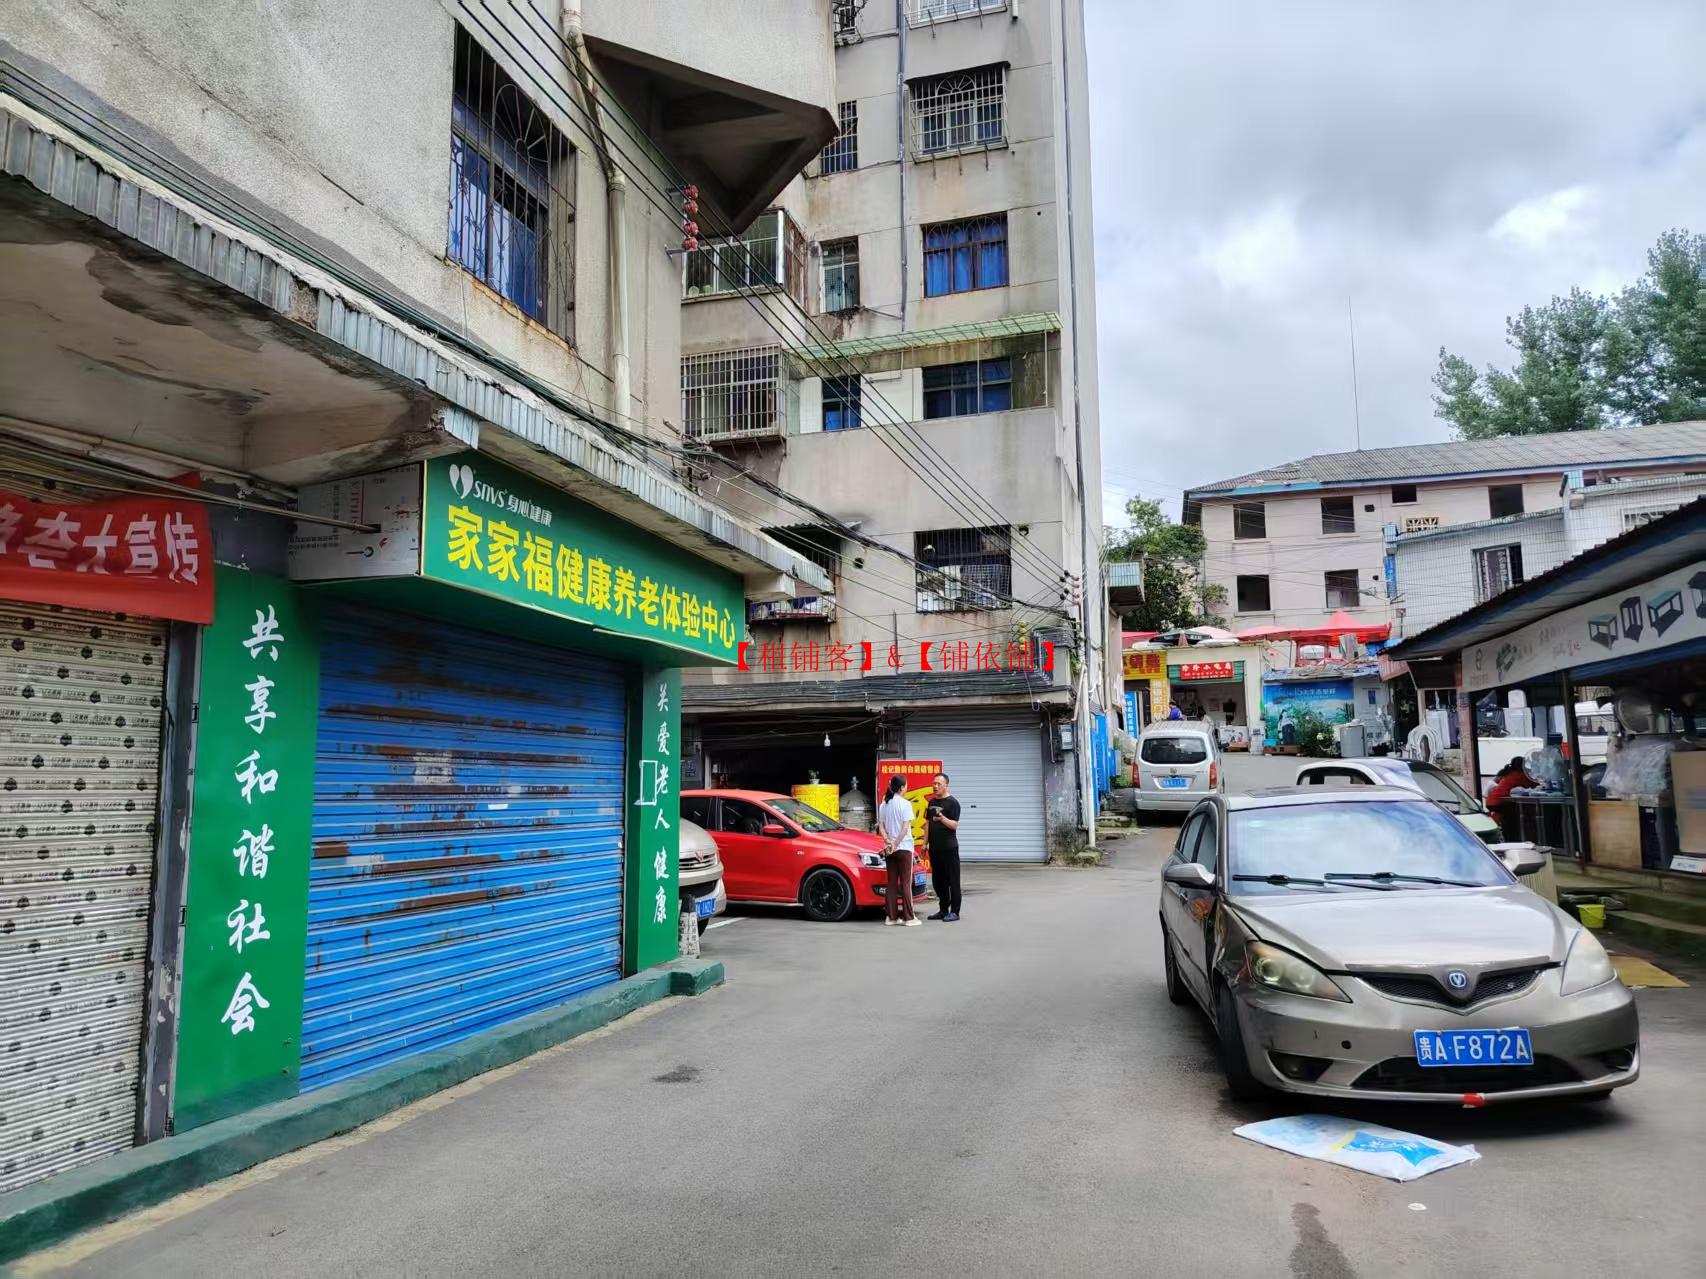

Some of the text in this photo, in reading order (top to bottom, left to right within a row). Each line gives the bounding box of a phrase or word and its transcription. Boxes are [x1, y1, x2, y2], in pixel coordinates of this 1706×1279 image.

[447, 503, 735, 649] 家家福健康养老体验中心
[507, 494, 553, 527] 身心健康
[221, 604, 285, 1036] 共享和谐社会
[654, 682, 671, 924] 关爱老人健康
